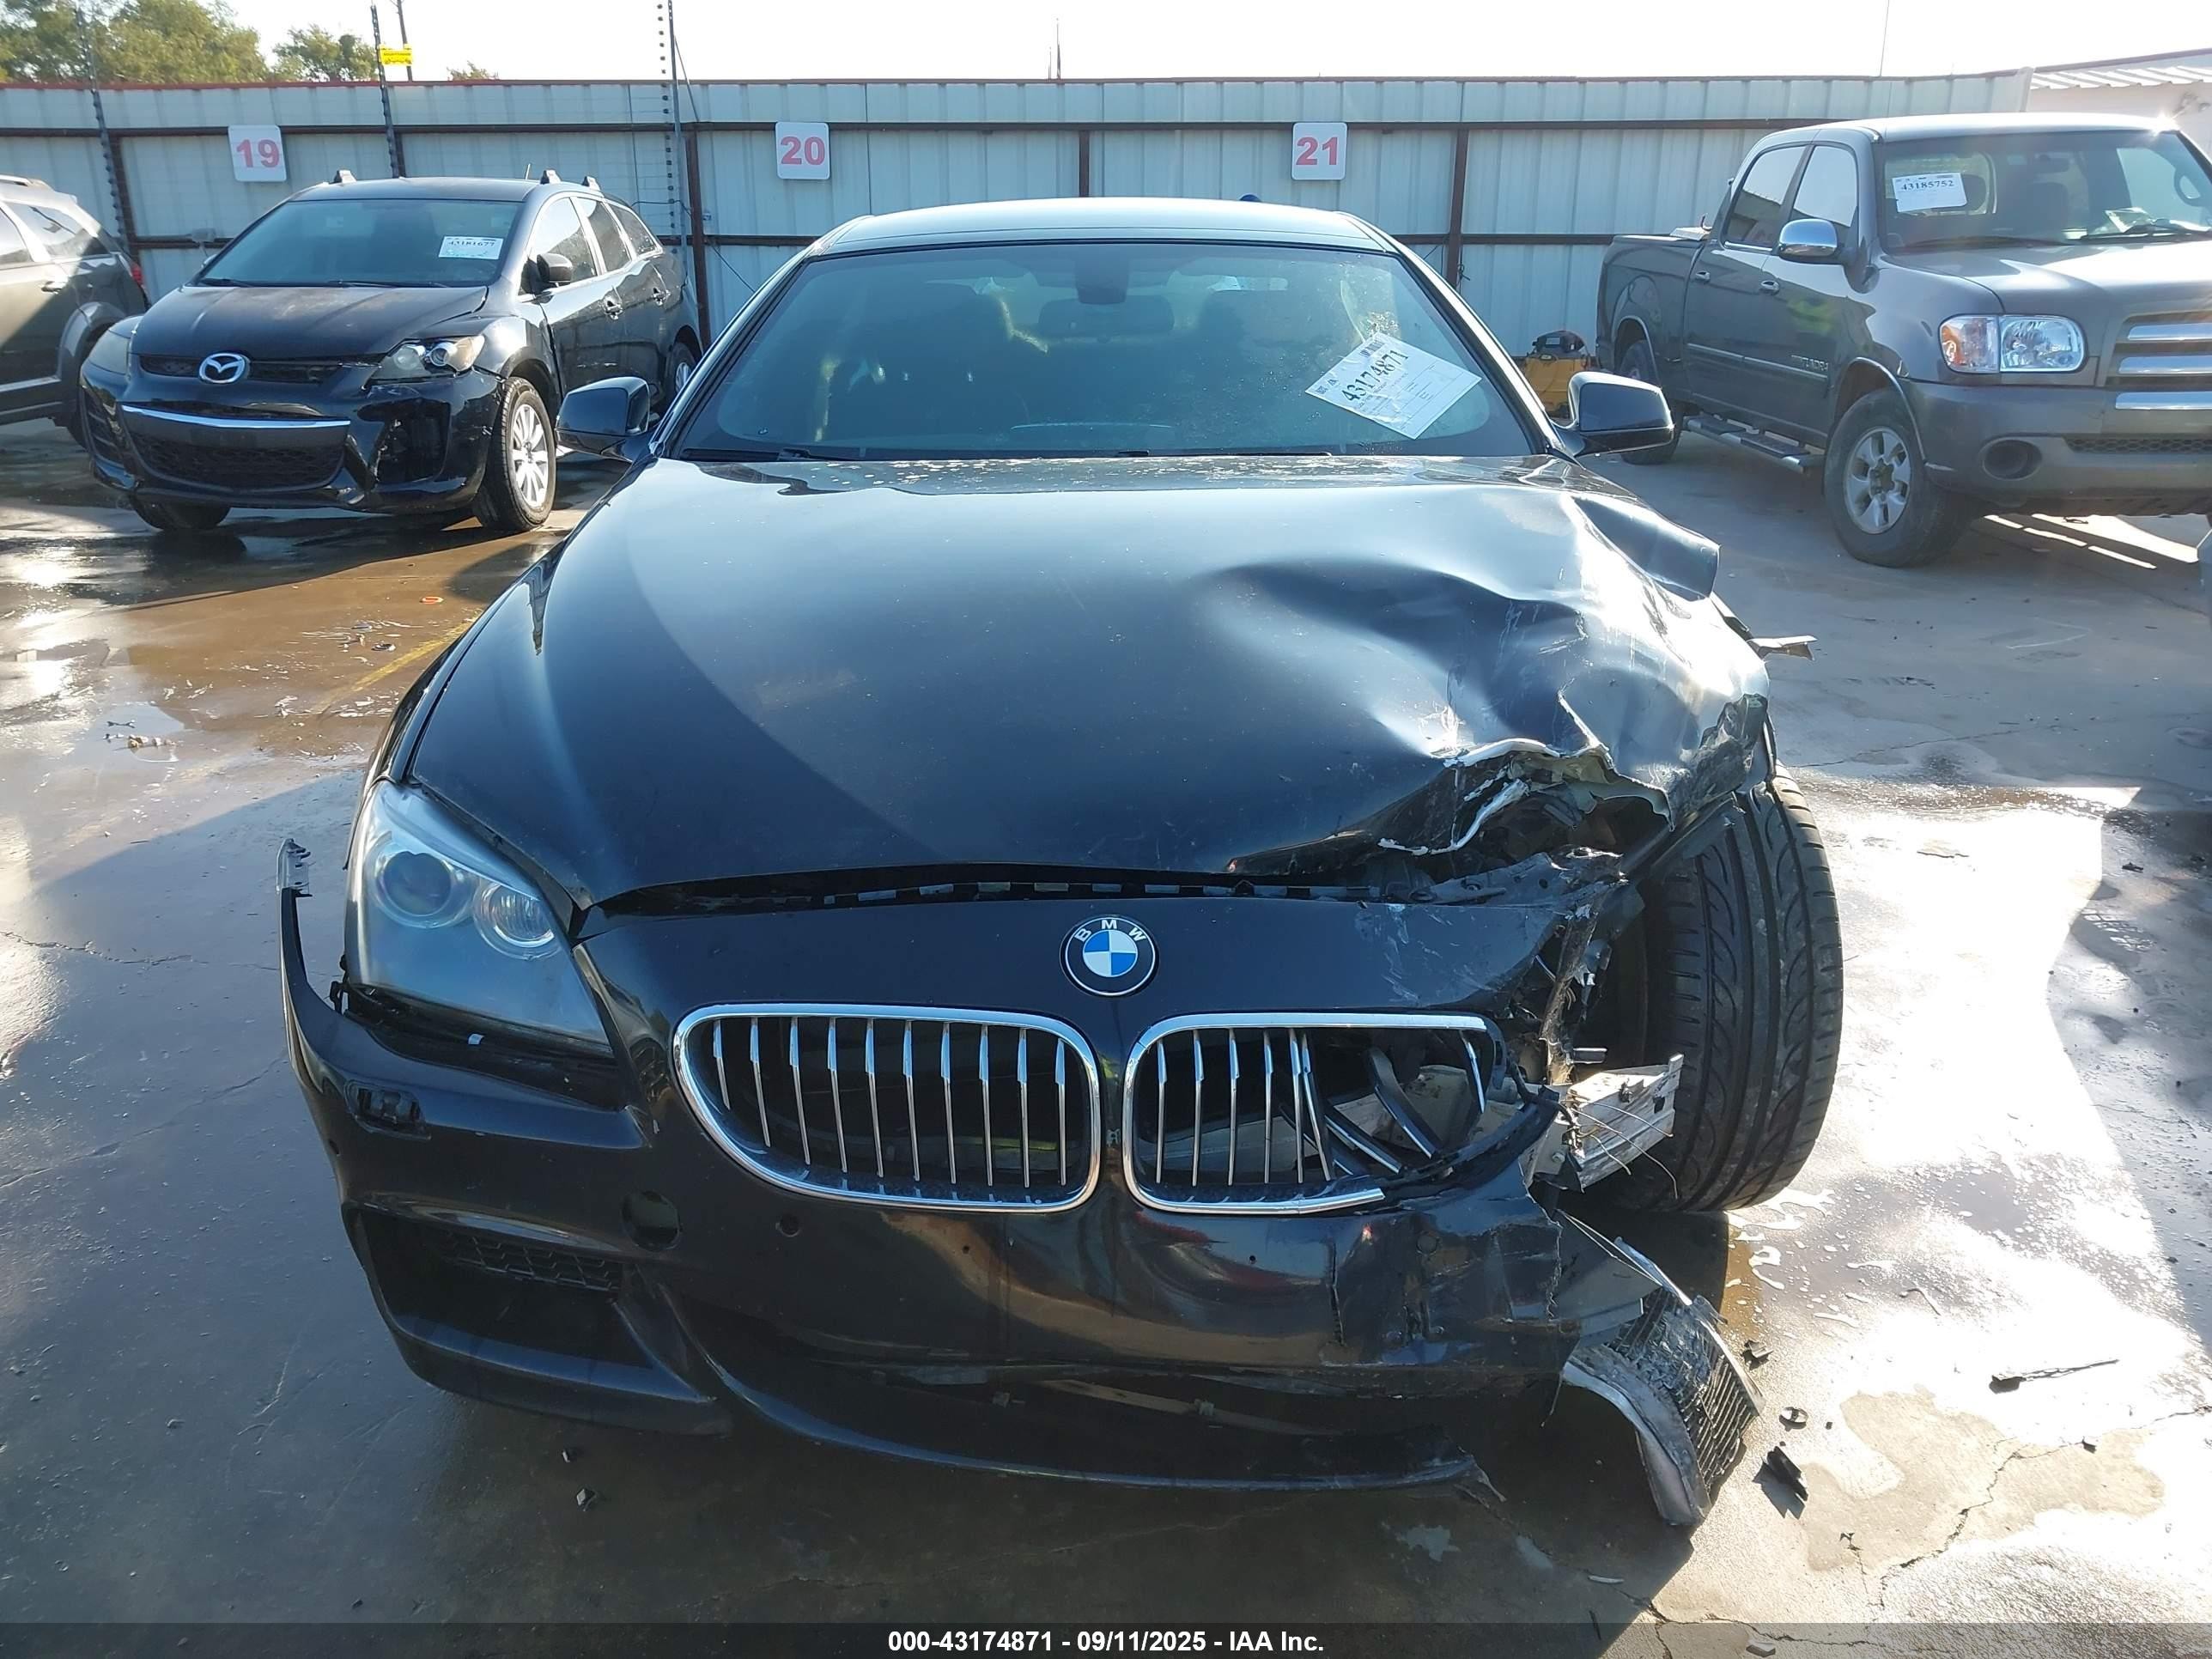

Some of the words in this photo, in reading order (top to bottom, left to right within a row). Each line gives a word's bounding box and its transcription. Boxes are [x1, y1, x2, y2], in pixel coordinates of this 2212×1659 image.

[236, 139, 279, 167] 19
[781, 137, 825, 165] 20
[1296, 137, 1337, 165] 21
[1901, 180, 1954, 190] 43185752
[1341, 349, 1408, 402] 43174871
[1074, 919, 1147, 942] BMW
